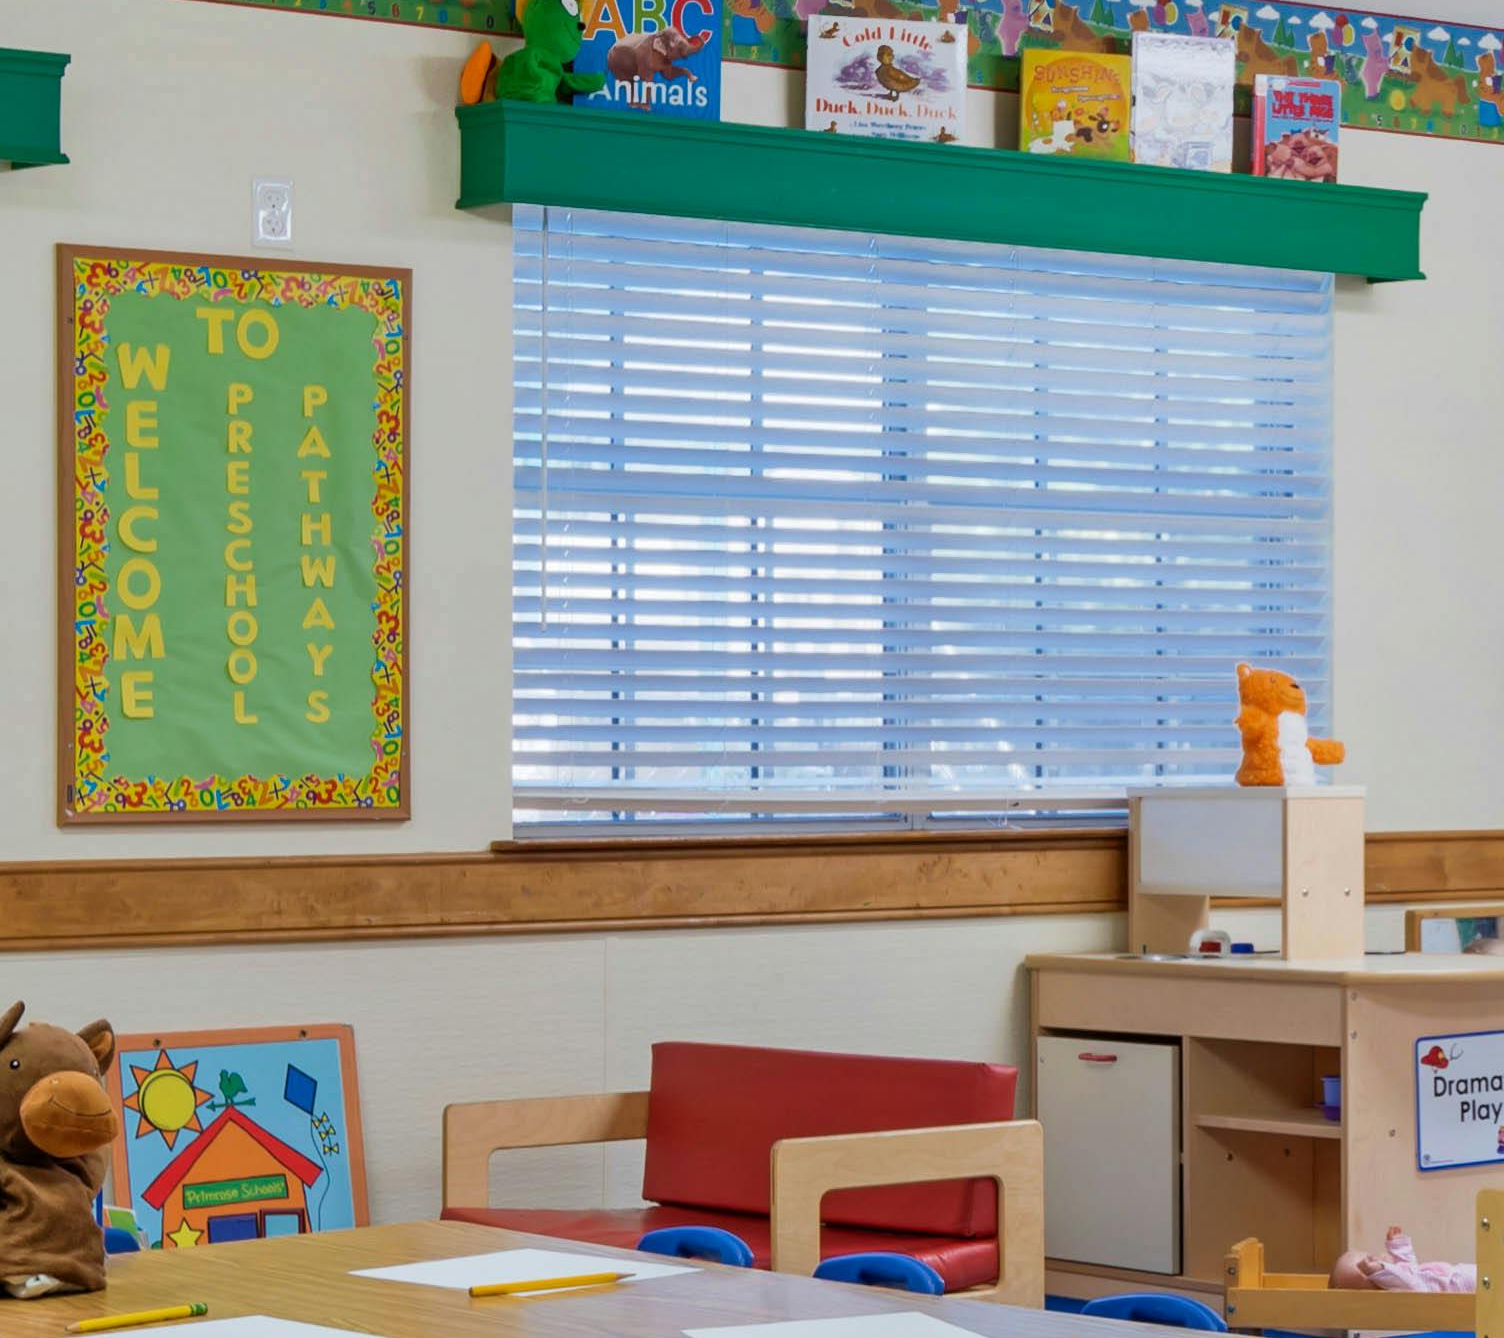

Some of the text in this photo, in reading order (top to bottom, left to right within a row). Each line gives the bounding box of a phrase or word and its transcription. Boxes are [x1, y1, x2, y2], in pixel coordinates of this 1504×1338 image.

[196, 308, 280, 360] TO
[113, 342, 170, 719] WELCOME
[224, 383, 259, 724] PRESCHOOL
[296, 384, 337, 724] PATHWAYS
[1460, 1099, 1503, 1124] Play
